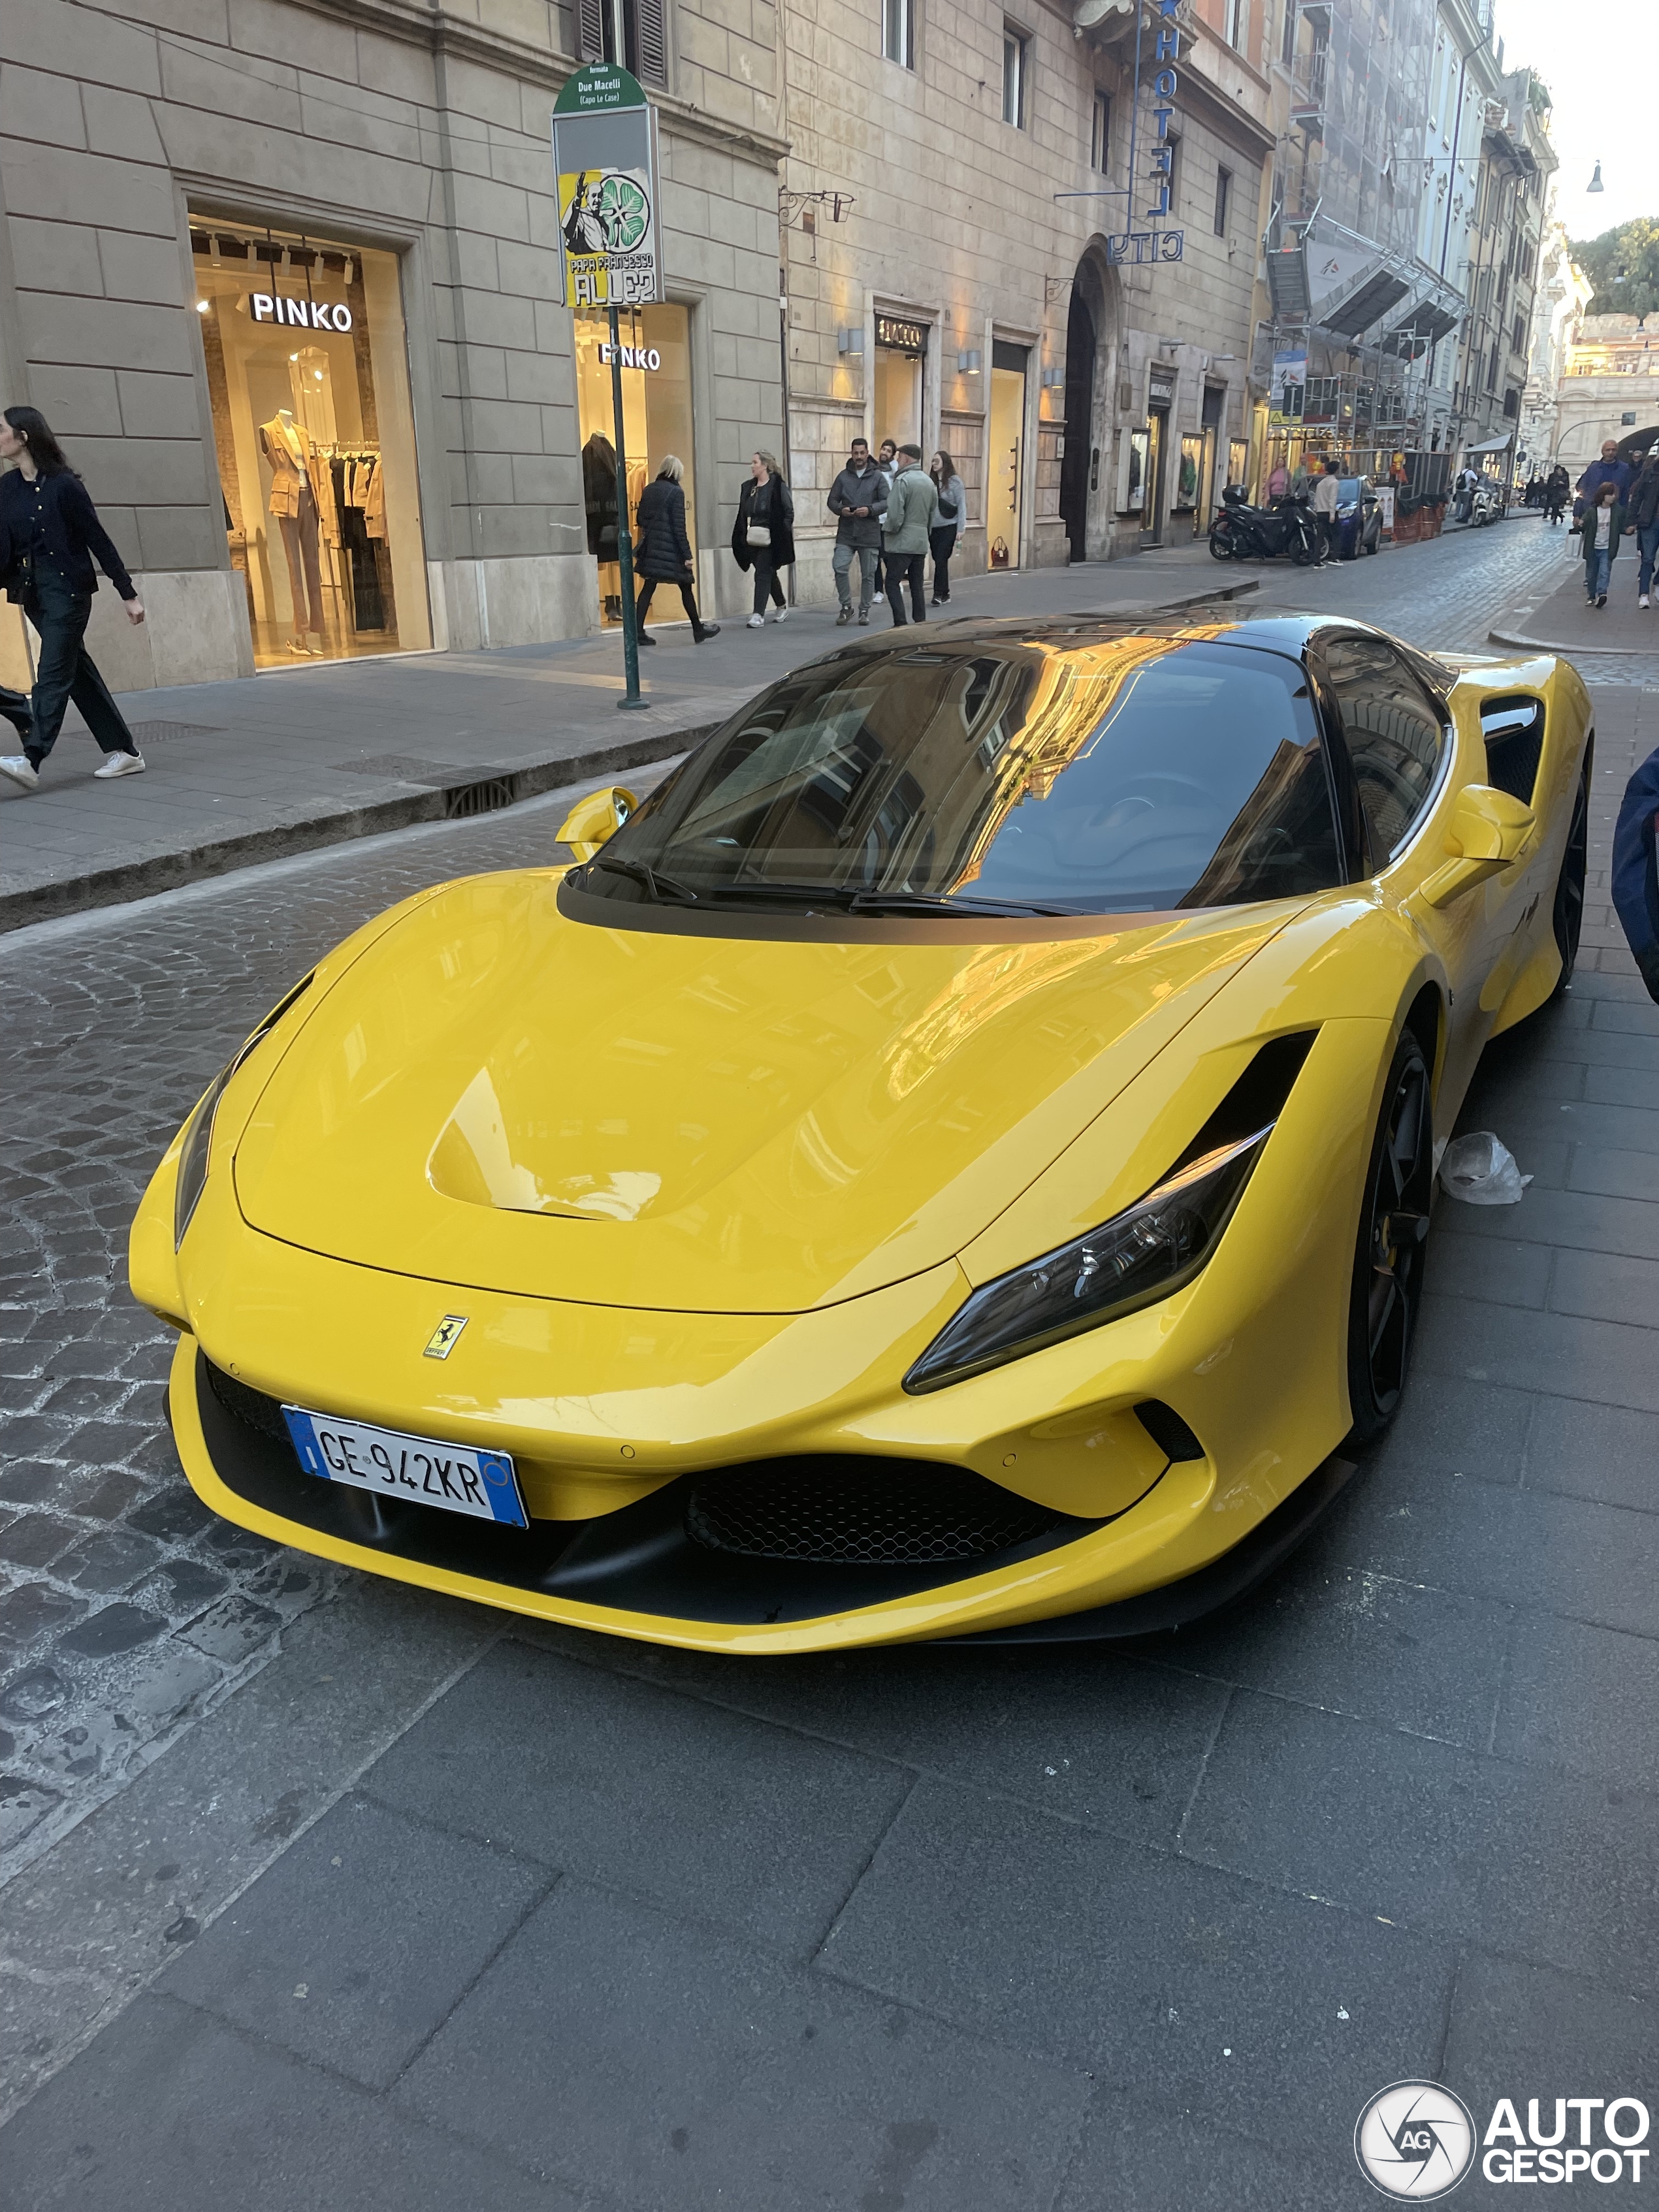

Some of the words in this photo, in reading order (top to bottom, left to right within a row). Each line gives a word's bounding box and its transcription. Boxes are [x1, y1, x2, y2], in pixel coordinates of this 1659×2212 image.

[578, 82, 592, 92] Due
[594, 78, 620, 90] Macelli
[580, 95, 596, 105] (Capo
[604, 92, 619, 102] Case)
[571, 258, 596, 273] PAPA
[598, 253, 653, 271] FRANCESCO
[253, 293, 352, 332] PINKO
[601, 344, 660, 370] PNKO
